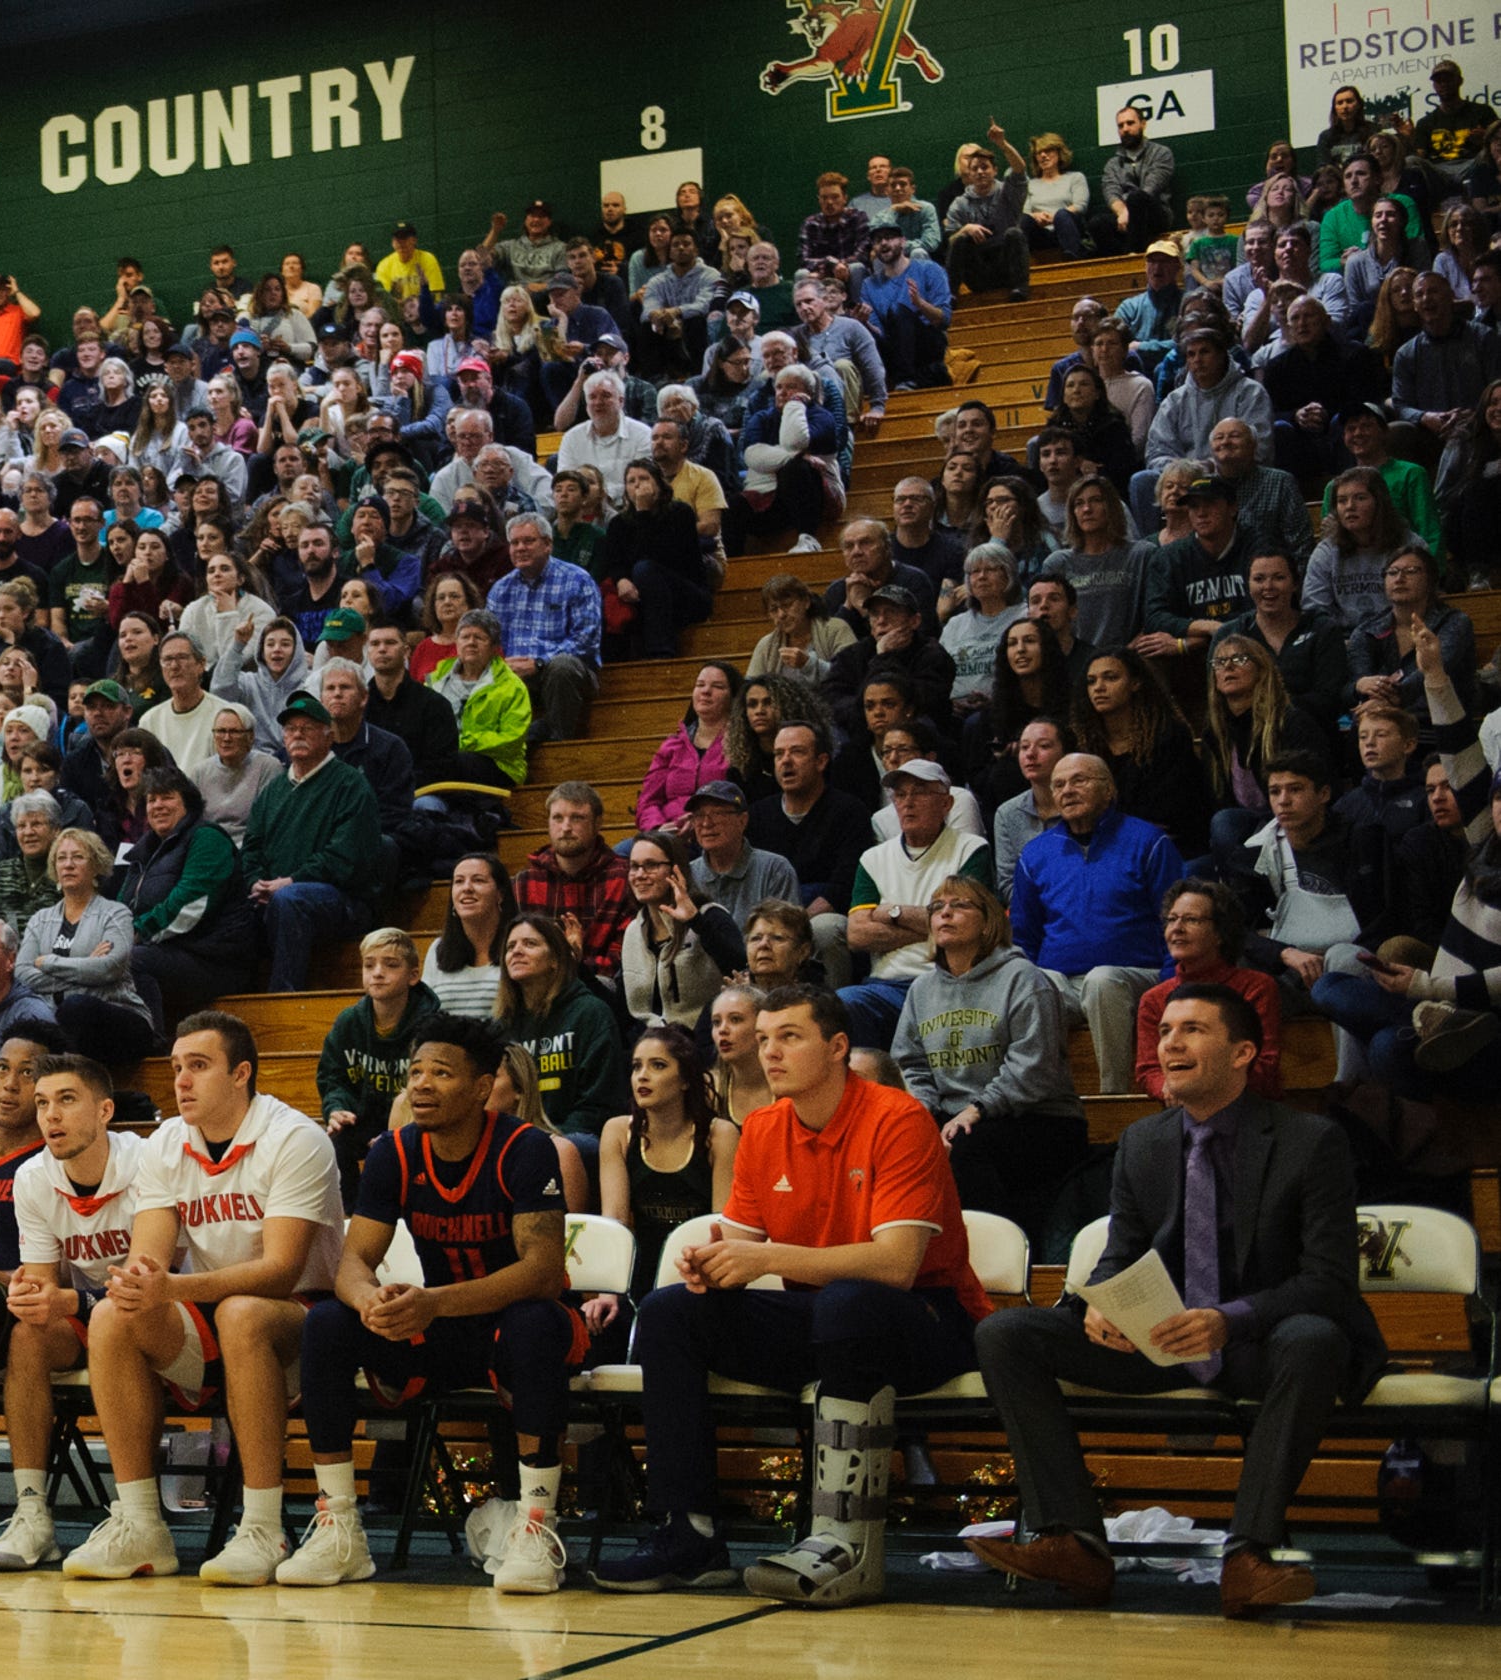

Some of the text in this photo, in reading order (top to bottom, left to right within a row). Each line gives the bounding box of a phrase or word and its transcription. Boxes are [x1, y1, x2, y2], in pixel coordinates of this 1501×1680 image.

[1122, 23, 1180, 76] 10
[1299, 18, 1476, 69] REDSTONE
[1125, 90, 1186, 121] GA
[40, 55, 416, 195] COUNTRY
[640, 105, 667, 151] 8
[1337, 582, 1385, 595] VERMON
[954, 660, 996, 677] ERMON
[927, 1044, 1001, 1069] ERMONT
[444, 1247, 488, 1283] 11
